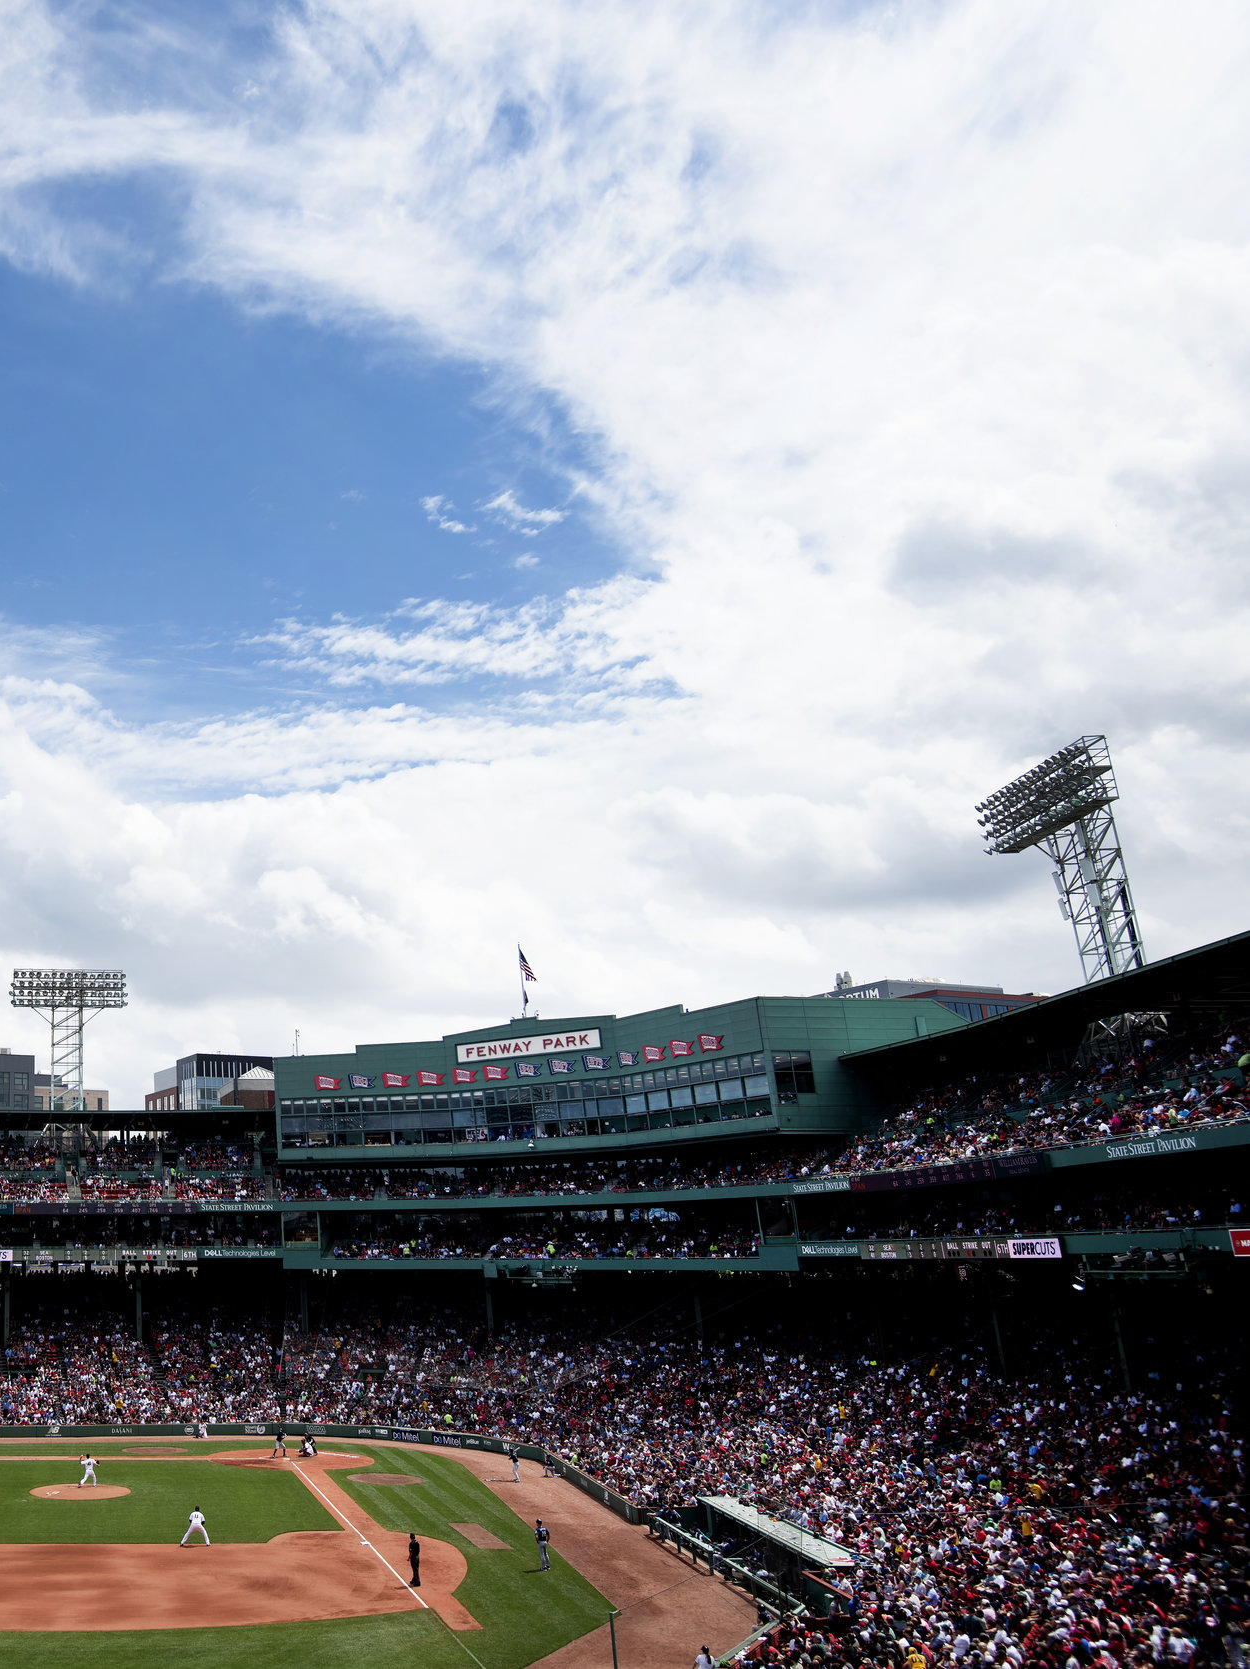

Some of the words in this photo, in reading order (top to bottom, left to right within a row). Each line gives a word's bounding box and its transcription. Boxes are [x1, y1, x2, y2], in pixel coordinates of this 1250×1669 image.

[466, 1040, 532, 1061] FENWAY
[542, 1033, 591, 1050] PARK
[1106, 1145, 1129, 1158] STATE
[1128, 1142, 1156, 1156] STREET
[1156, 1137, 1197, 1152] PAVILION
[807, 1182, 825, 1192] STREET
[825, 1180, 850, 1191] PAVILION
[201, 1203, 219, 1211] STATE
[220, 1203, 242, 1211] STREET
[244, 1203, 274, 1211] PAVILION
[801, 1244, 816, 1254] DELL
[815, 1244, 845, 1256] Technologies
[845, 1243, 858, 1254] Level
[947, 1242, 959, 1250] BALL
[962, 1241, 979, 1250] STRIKE
[981, 1241, 991, 1249] OUT
[997, 1243, 1008, 1254] 6TH
[1013, 1242, 1055, 1255] SUPERCUTS
[222, 1249, 260, 1258] Technologies
[260, 1249, 276, 1257] Level
[881, 1251, 897, 1259] BOSTON
[401, 1432, 420, 1442] Mitel
[442, 1435, 462, 1448] Mitel
